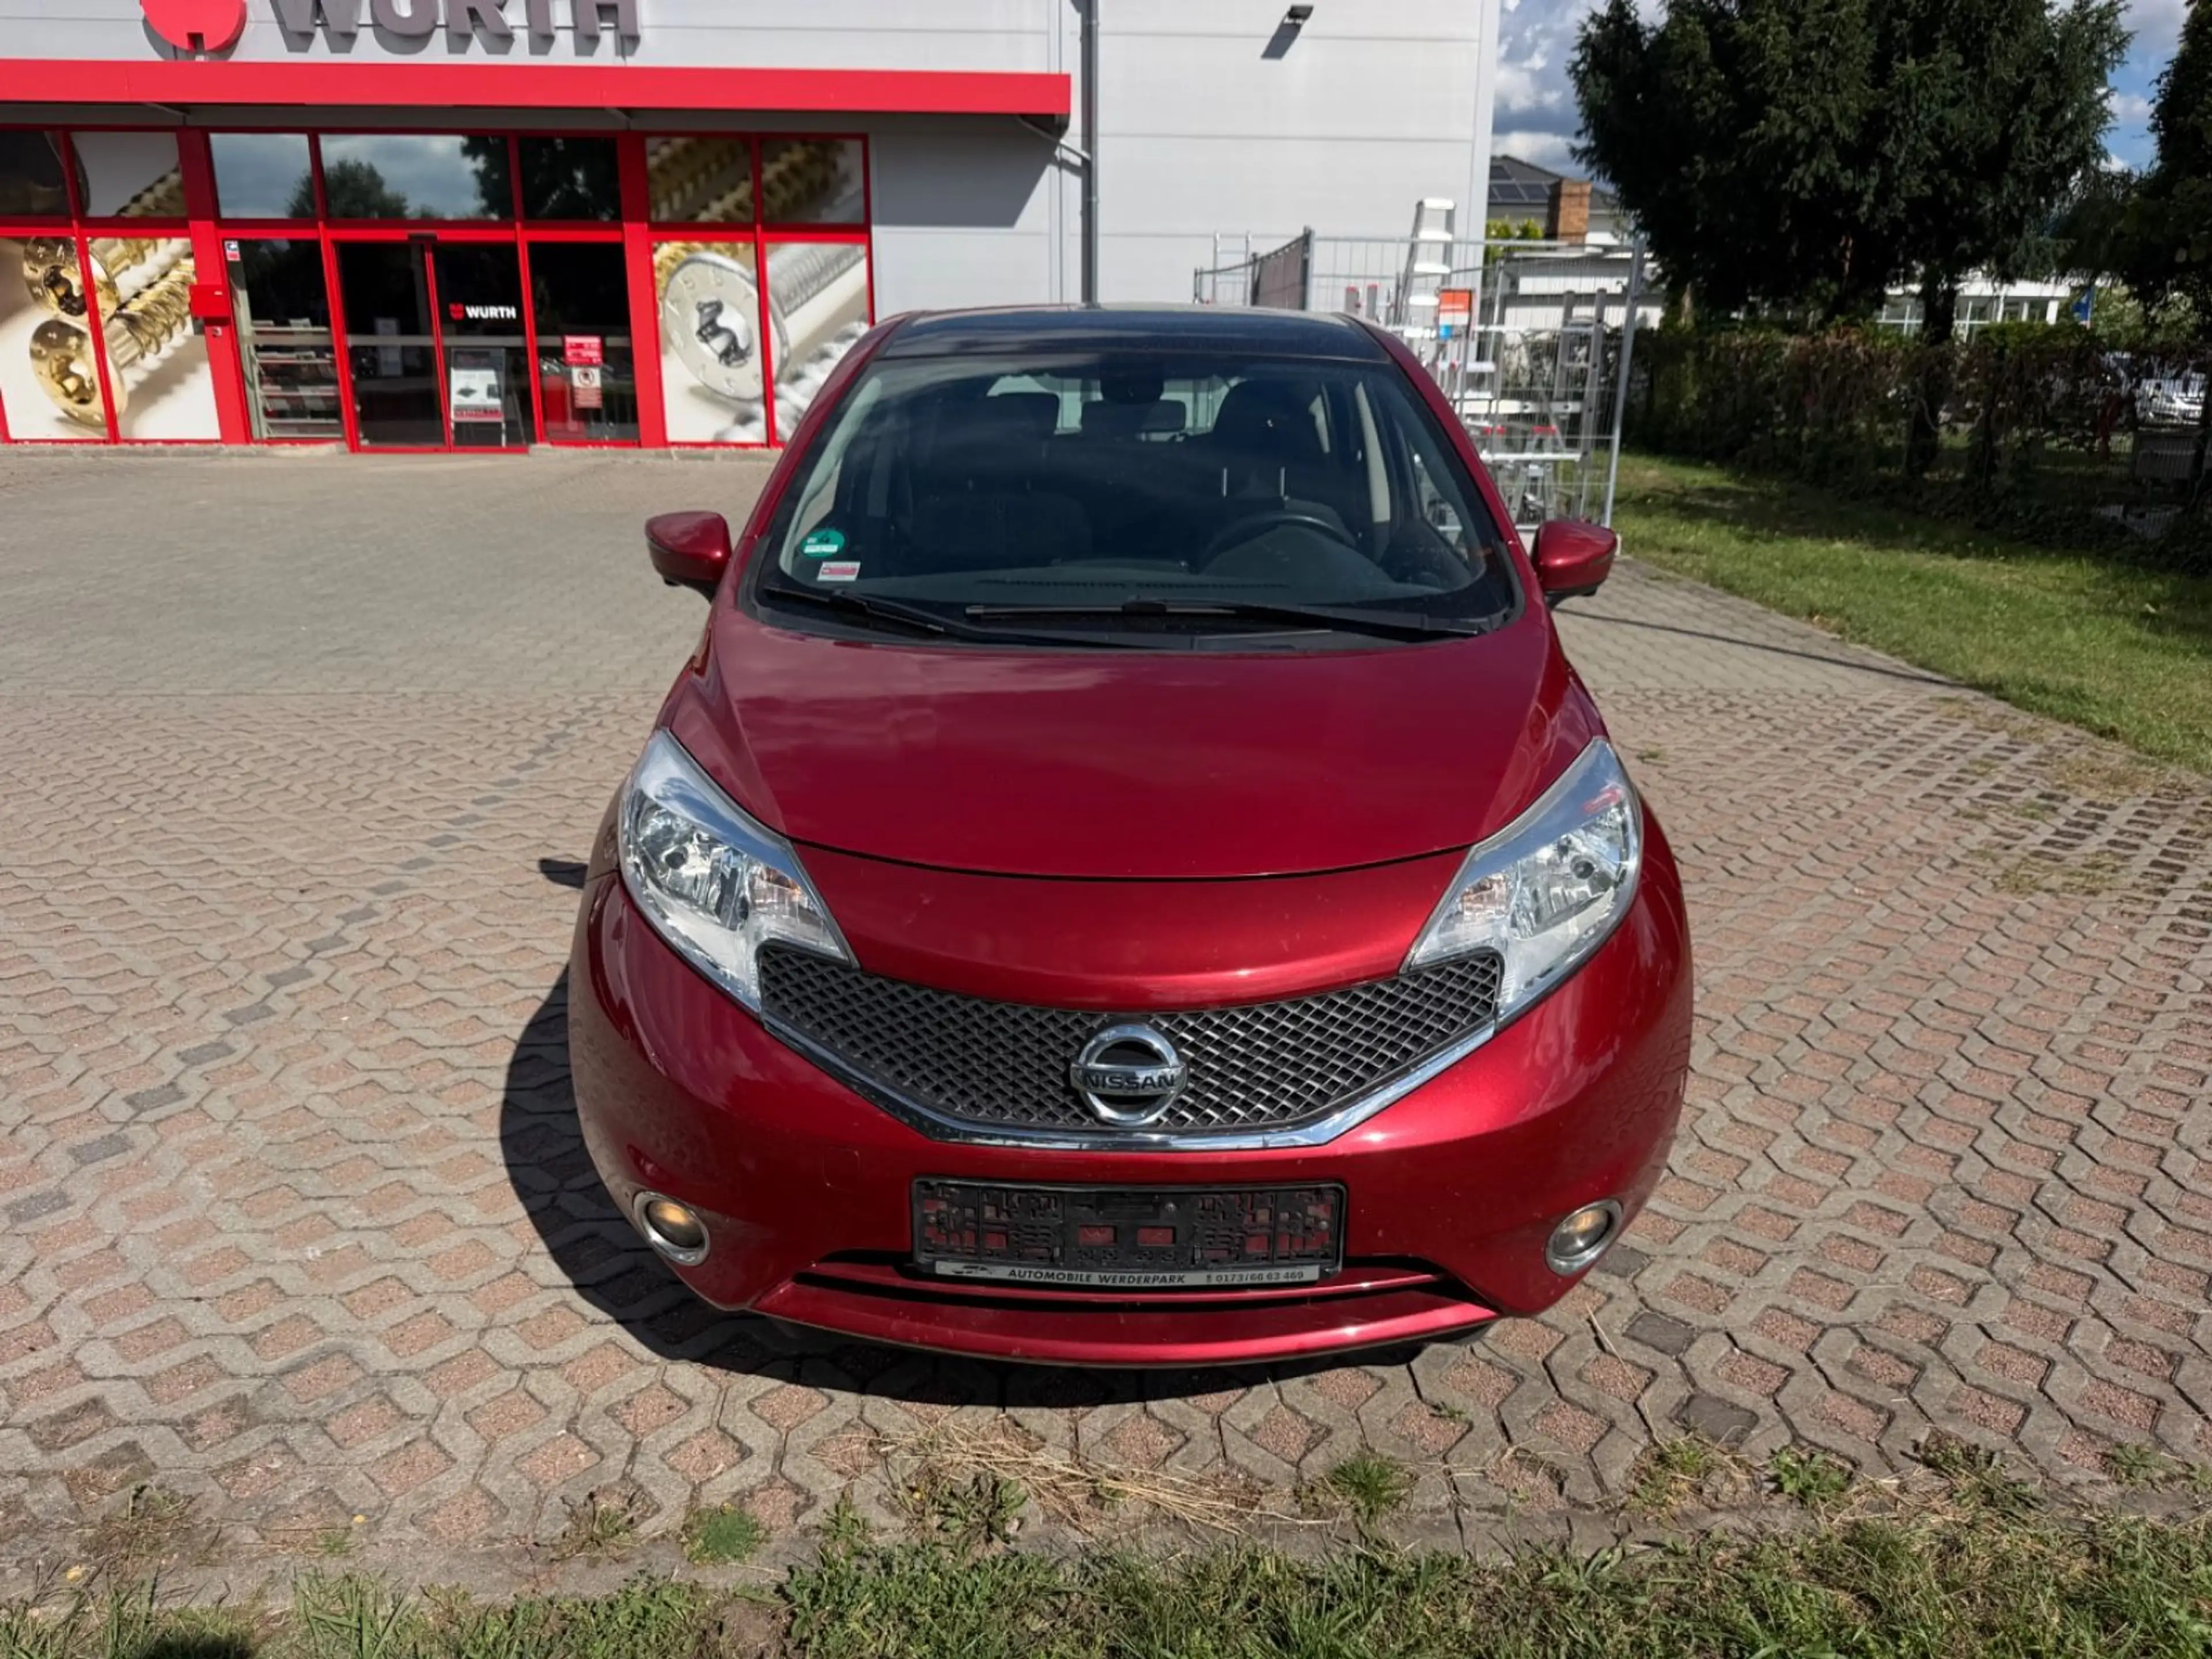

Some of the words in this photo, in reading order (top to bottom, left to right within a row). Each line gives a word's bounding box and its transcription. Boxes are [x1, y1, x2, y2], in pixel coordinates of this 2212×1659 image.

[1082, 1071, 1175, 1090] NISSAN
[1008, 1269, 1092, 1282] AUTOMOBILE
[1099, 1274, 1184, 1284] WERDERPARK
